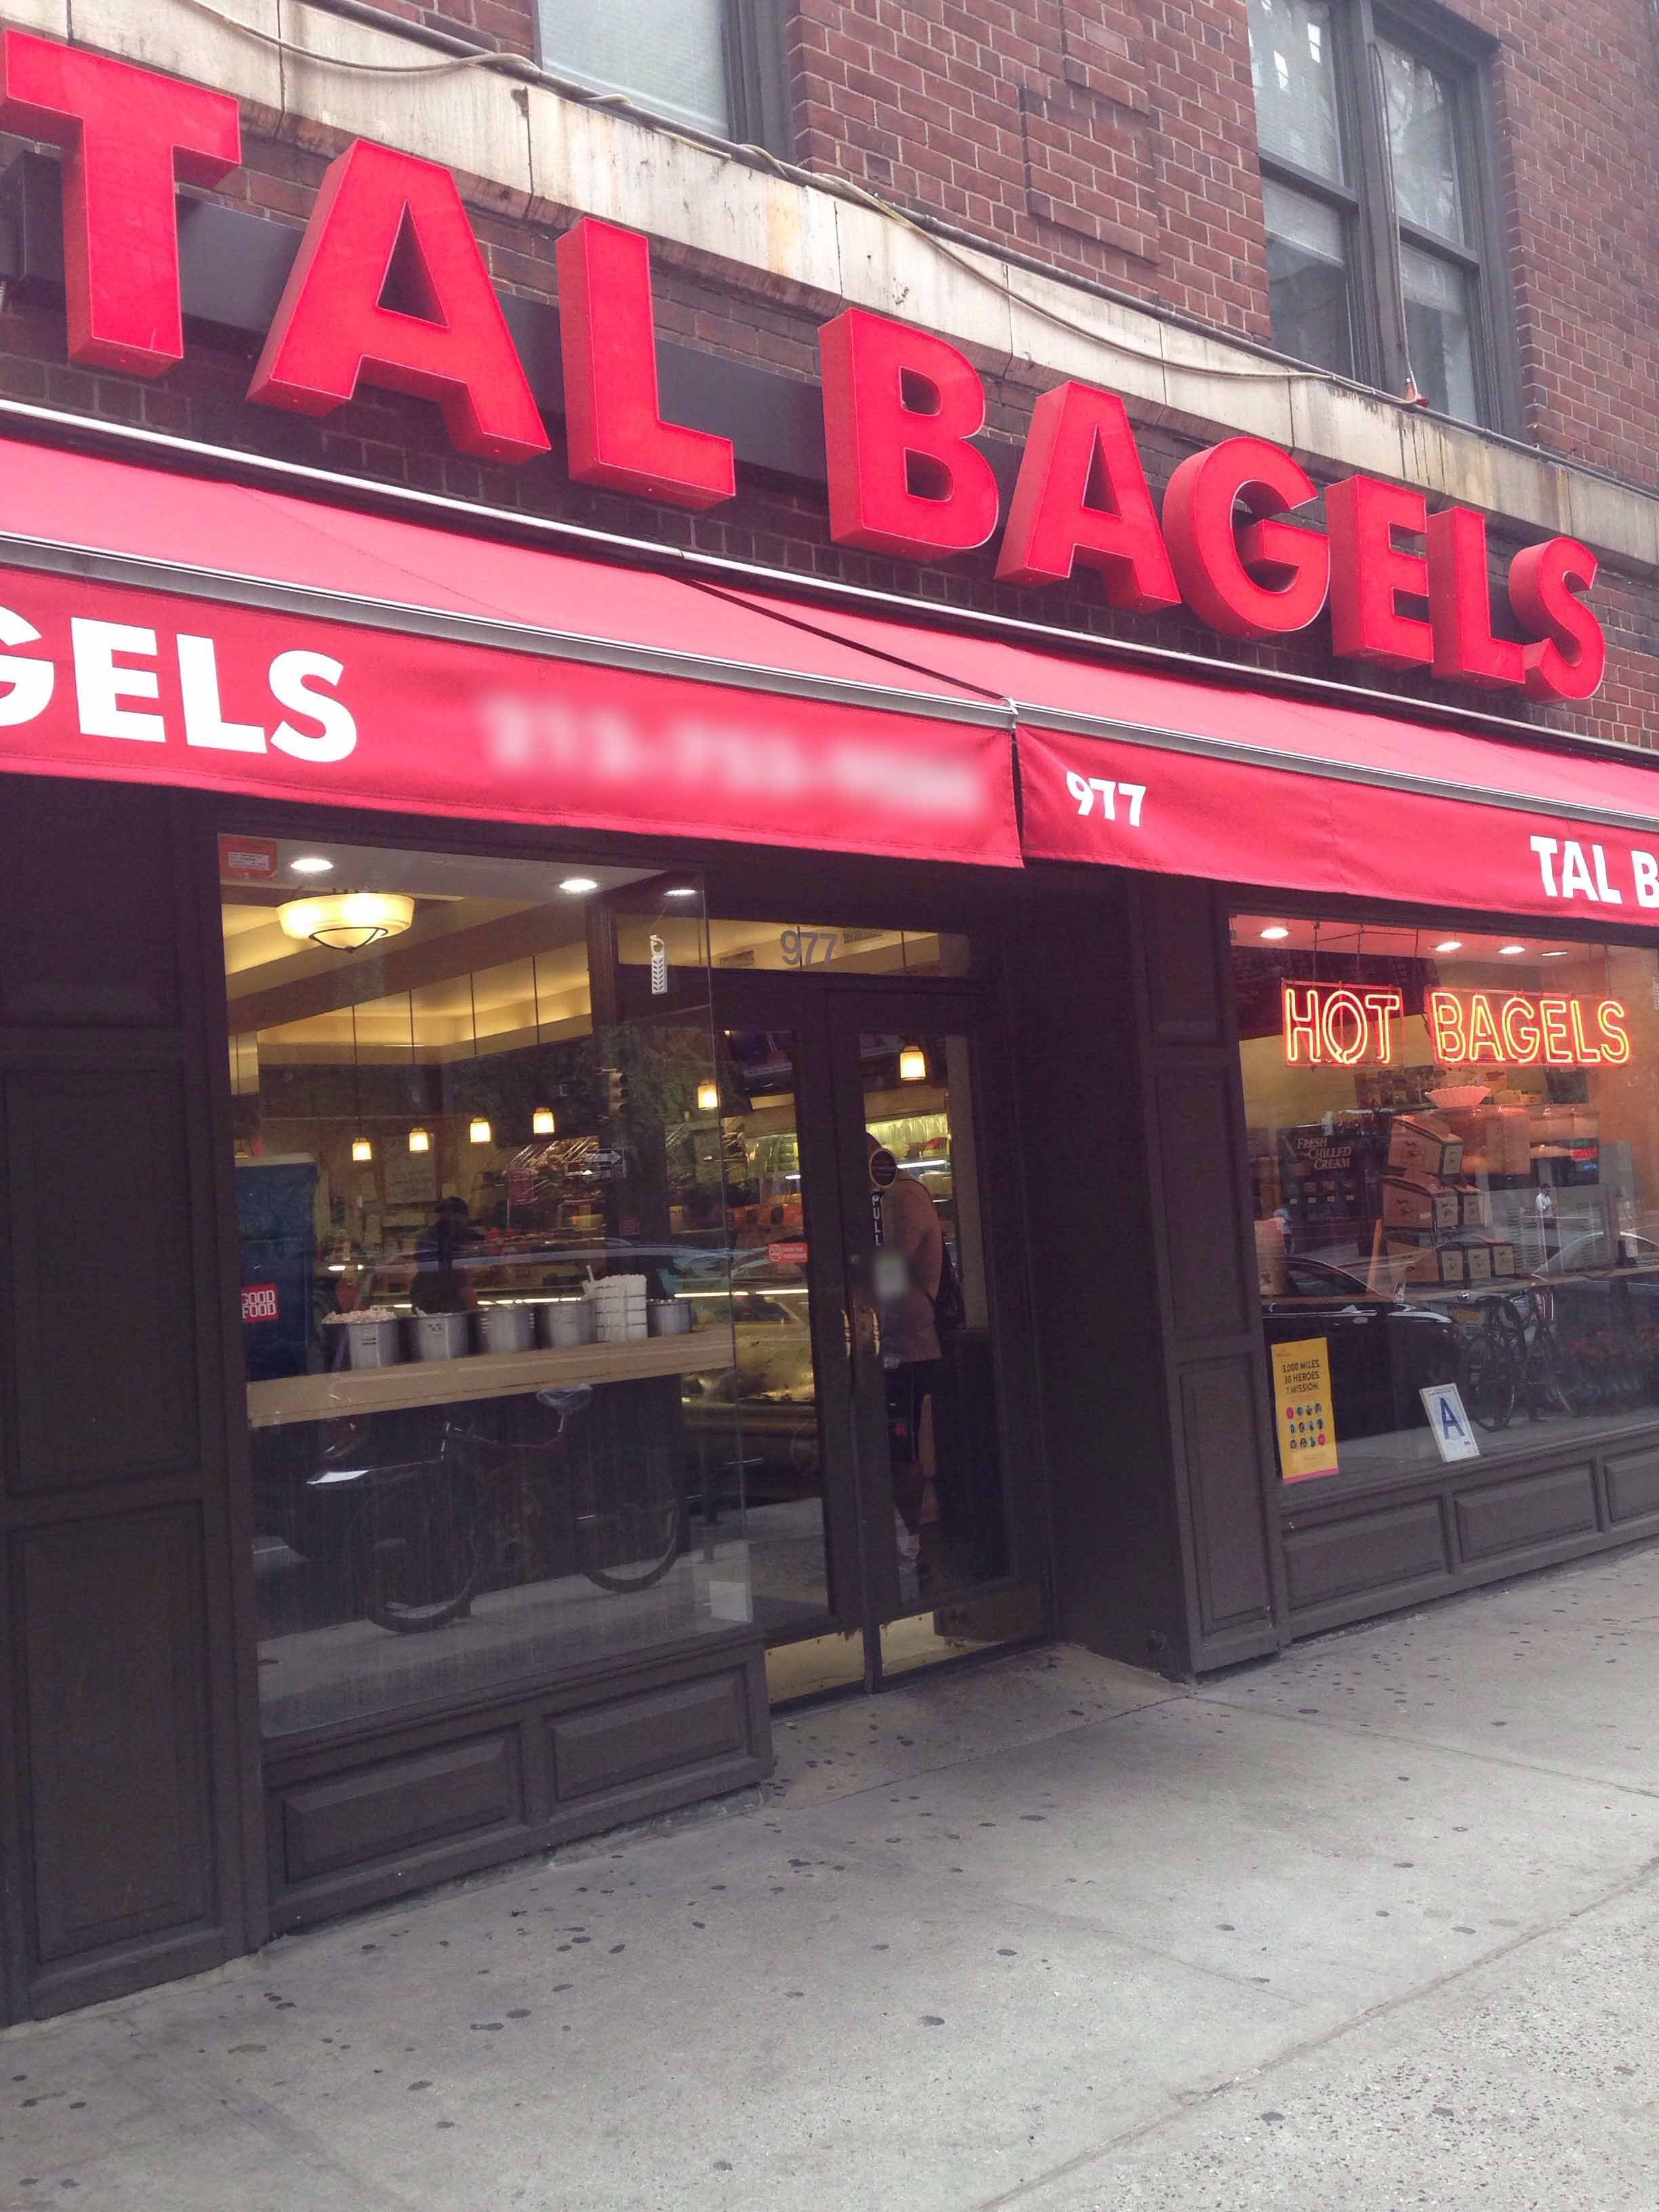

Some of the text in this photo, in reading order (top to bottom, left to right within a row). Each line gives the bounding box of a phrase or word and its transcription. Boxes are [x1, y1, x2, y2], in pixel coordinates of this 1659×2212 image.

[1, 29, 1605, 703] TAL BAGELS
[1066, 770, 1146, 827] 977
[1530, 835, 1622, 905] TAL
[781, 930, 838, 966] 977
[1286, 989, 1630, 1064] HOT BAGELS
[1297, 1138, 1328, 1149] FRESH
[1308, 1146, 1352, 1160] CHILLED
[1314, 1158, 1350, 1170] CREAM
[872, 1193, 881, 1247] PULL
[242, 1303, 276, 1319] FOOD
[1440, 1397, 1465, 1439] A
